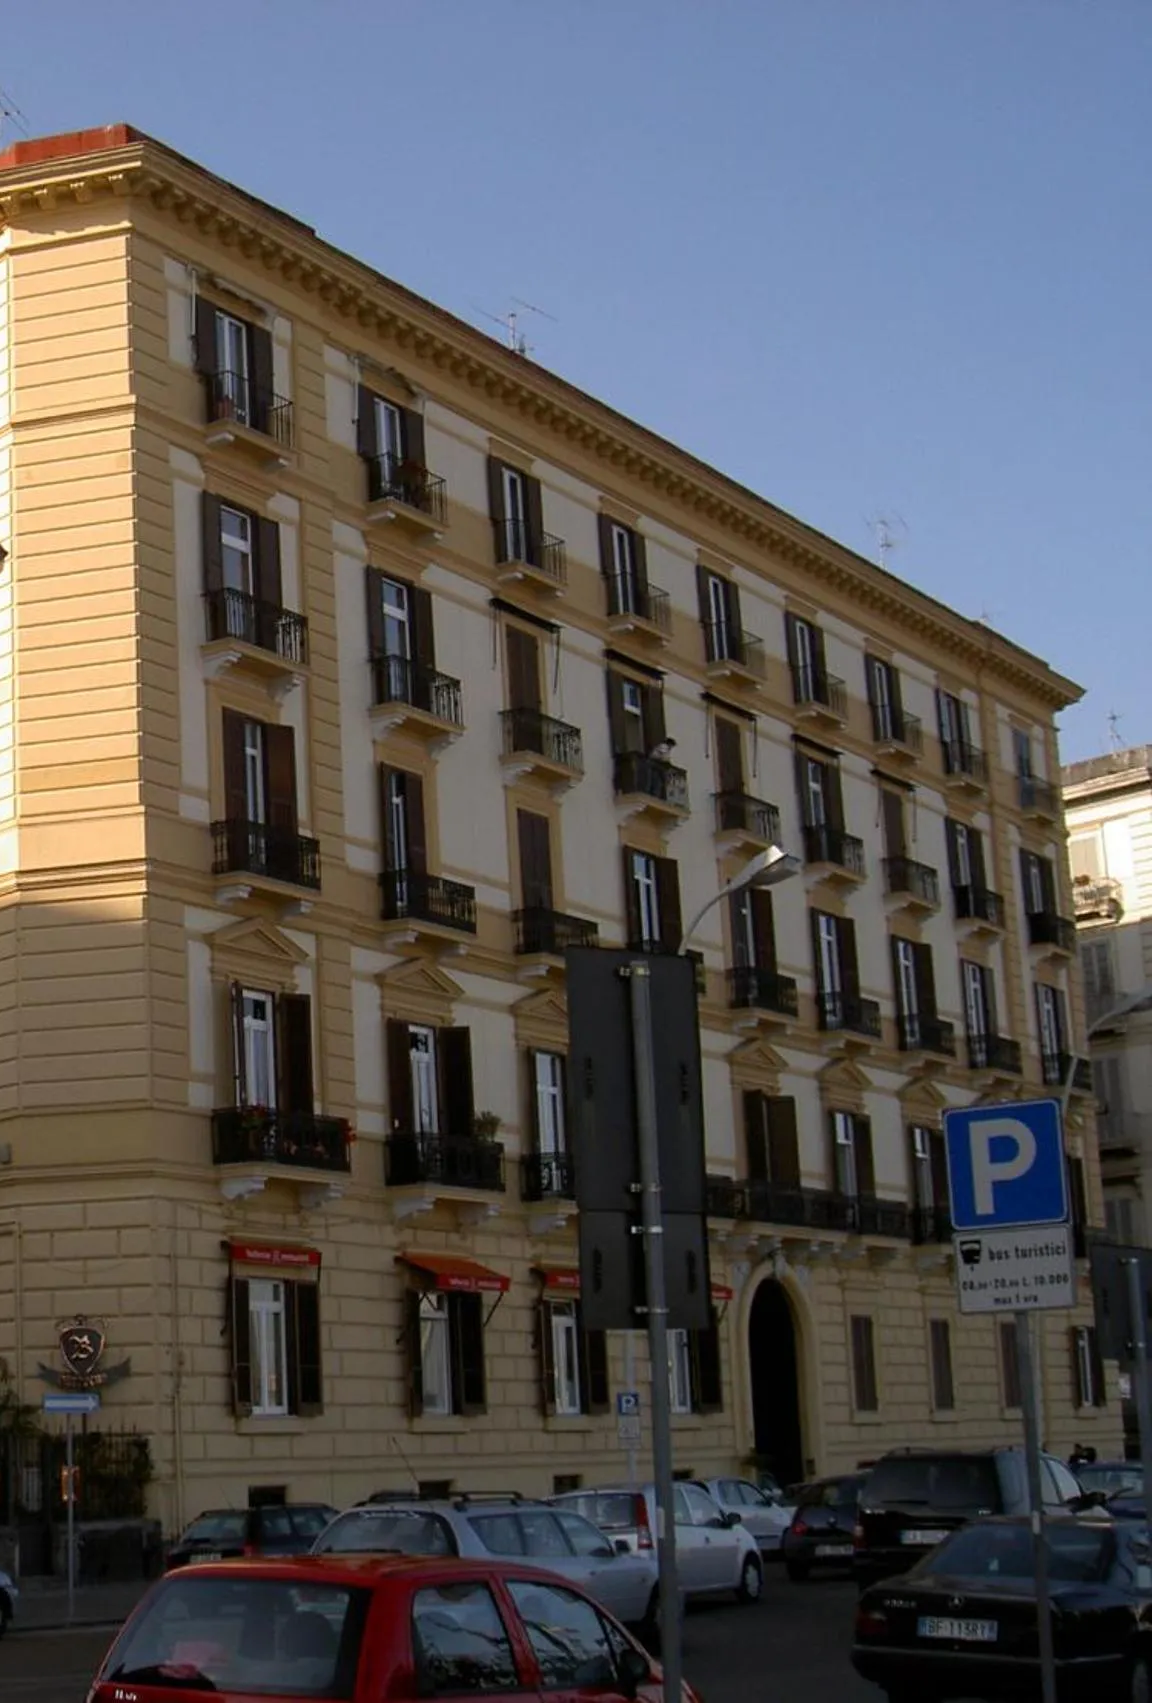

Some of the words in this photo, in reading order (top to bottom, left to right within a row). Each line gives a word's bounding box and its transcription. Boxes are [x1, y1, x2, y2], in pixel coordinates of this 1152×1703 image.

[969, 1118, 1037, 1215] P
[988, 1247, 1010, 1261] bus
[1015, 1242, 1066, 1259] turistici
[621, 1396, 635, 1413] P
